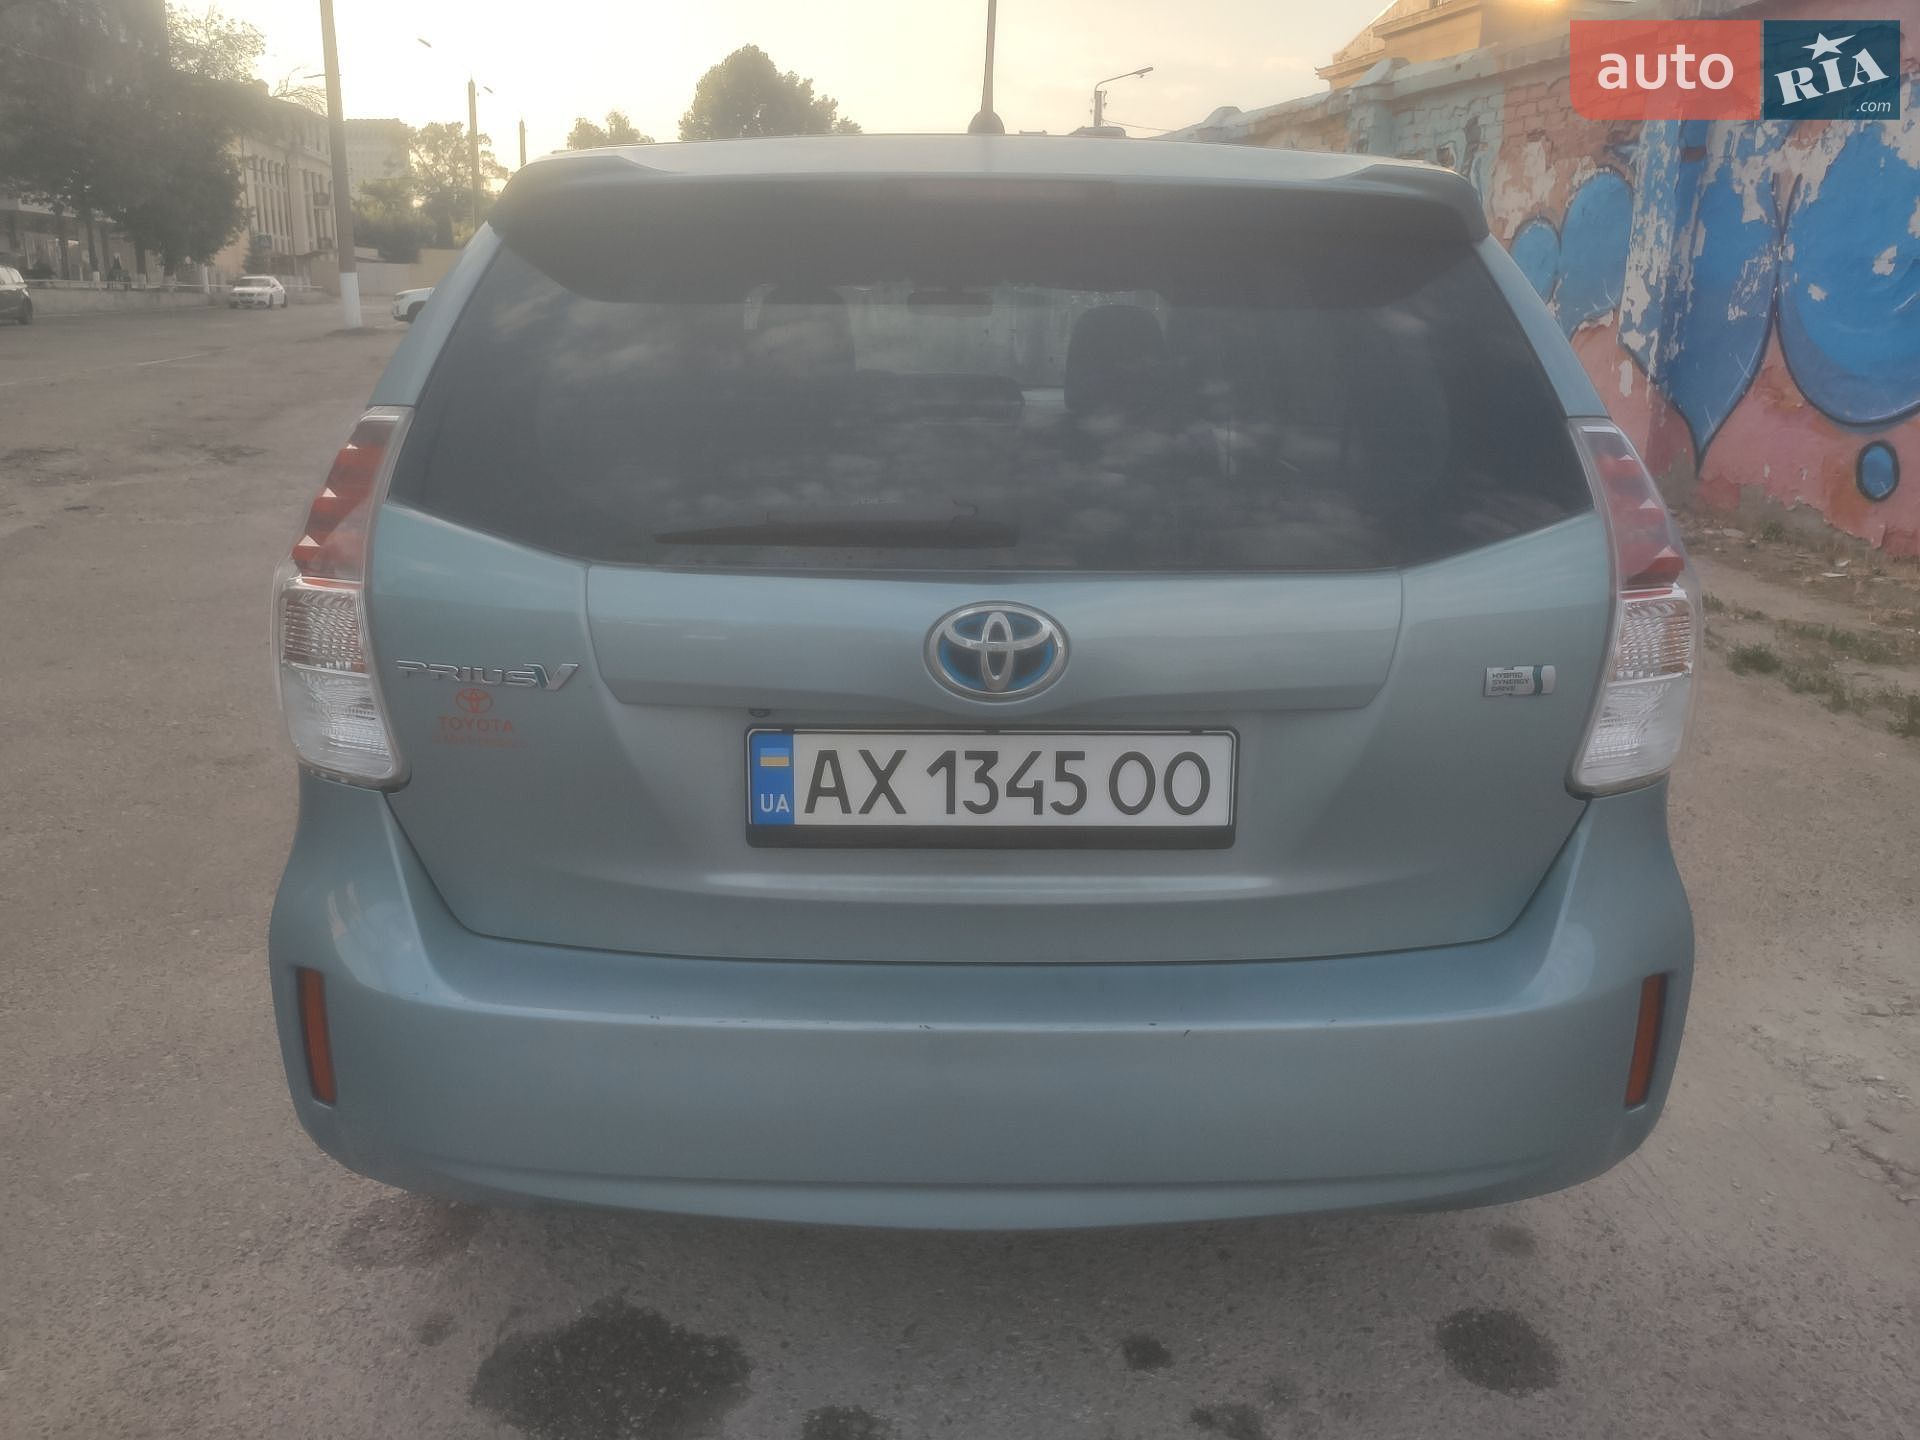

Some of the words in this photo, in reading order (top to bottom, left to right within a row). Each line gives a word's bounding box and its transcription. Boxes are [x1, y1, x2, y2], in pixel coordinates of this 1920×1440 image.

[396, 660, 537, 686] PRIUS
[438, 716, 513, 732] TOYOTA
[804, 749, 907, 815] AX
[926, 749, 1088, 816] 1345
[760, 793, 790, 812] UA
